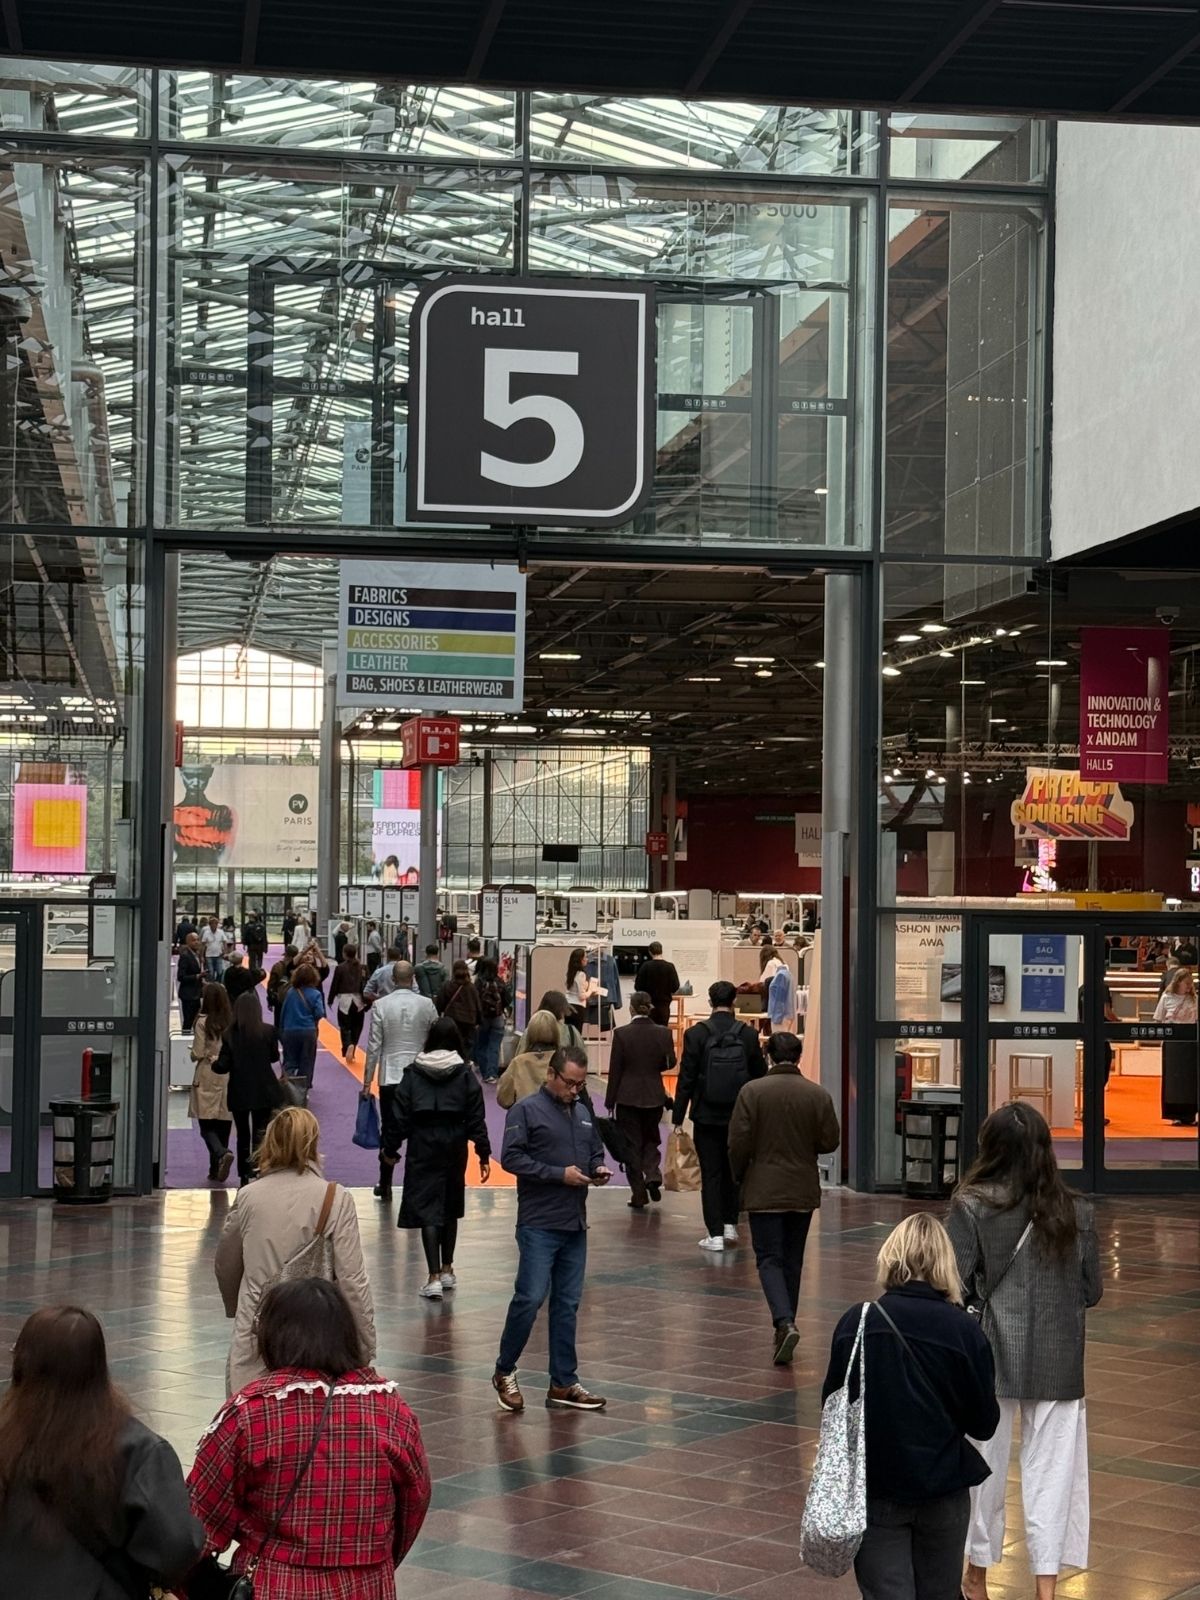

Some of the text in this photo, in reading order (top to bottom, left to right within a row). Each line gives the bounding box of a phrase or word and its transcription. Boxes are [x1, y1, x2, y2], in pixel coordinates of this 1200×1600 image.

[766, 204, 818, 219] 5000
[471, 306, 526, 328] hall
[480, 348, 584, 488] 5
[354, 586, 408, 605] FABRICS
[354, 608, 410, 627] DESIGNS
[352, 632, 440, 651] ACCESSORIES
[352, 653, 409, 672] LEATHER
[351, 676, 504, 696] BAG, SHOES & LEATHERWEAR
[1087, 695, 1162, 712] INNOVATION &
[421, 726, 455, 735] R.I.A.
[1087, 713, 1157, 729] TECHNOLOGY
[1086, 731, 1138, 747] x ANDAM
[283, 816, 313, 826] PARIS
[1015, 802, 1105, 825] SOURCING
[621, 927, 657, 939] Losanje
